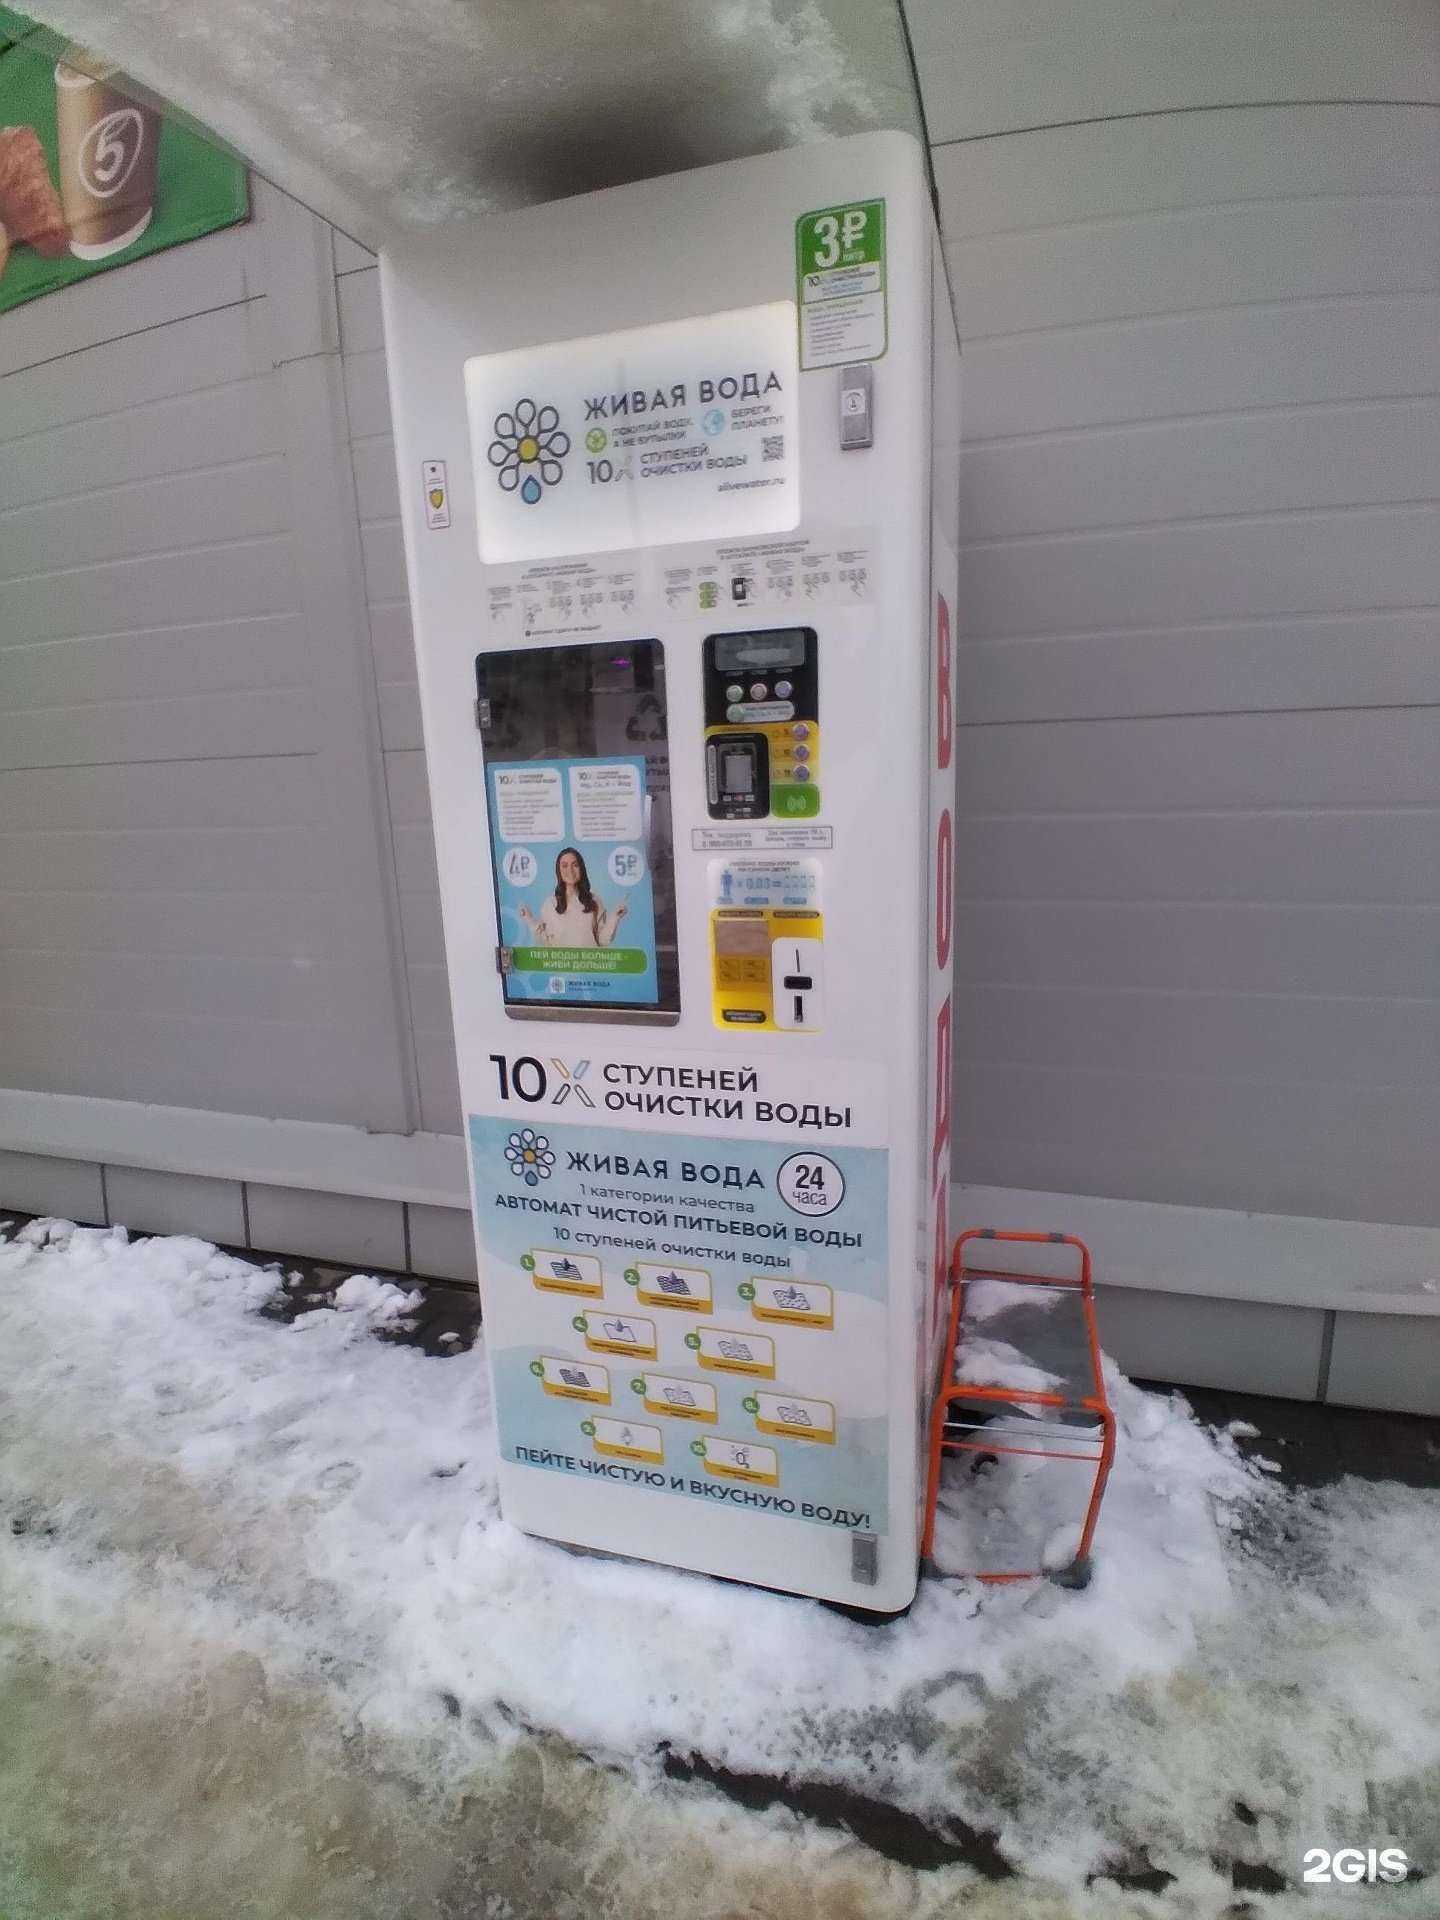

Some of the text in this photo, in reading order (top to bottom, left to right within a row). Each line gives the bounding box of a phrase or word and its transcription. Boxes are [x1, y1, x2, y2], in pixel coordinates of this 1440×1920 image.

[584, 371, 783, 421] ЖИВАЯ ВОДА
[640, 443, 711, 465] СТУПЕНЕЙ
[640, 454, 748, 479] ОЧИСТКИ ВОДЫ
[603, 1063, 758, 1093] СТУПЕНЕЙ
[604, 1091, 851, 1129] ОЧИСТКИ ВОДЫ
[567, 1151, 765, 1190] ЖИВАЯ ВОДА
[795, 1164, 825, 1190] 24
[580, 1184, 755, 1213] 1 категории качества
[792, 1190, 828, 1206] часа
[495, 1194, 862, 1249] АВТОМАТ ЧИСТОЙ ПИТЬЕВОЙ ВОДЫ
[553, 1226, 790, 1268] 10 ступеней очистки воды
[516, 1446, 871, 1529] ПЕЙТЕ ЧИСТУЮ И ВКУСНУЮ ВОДУ!
